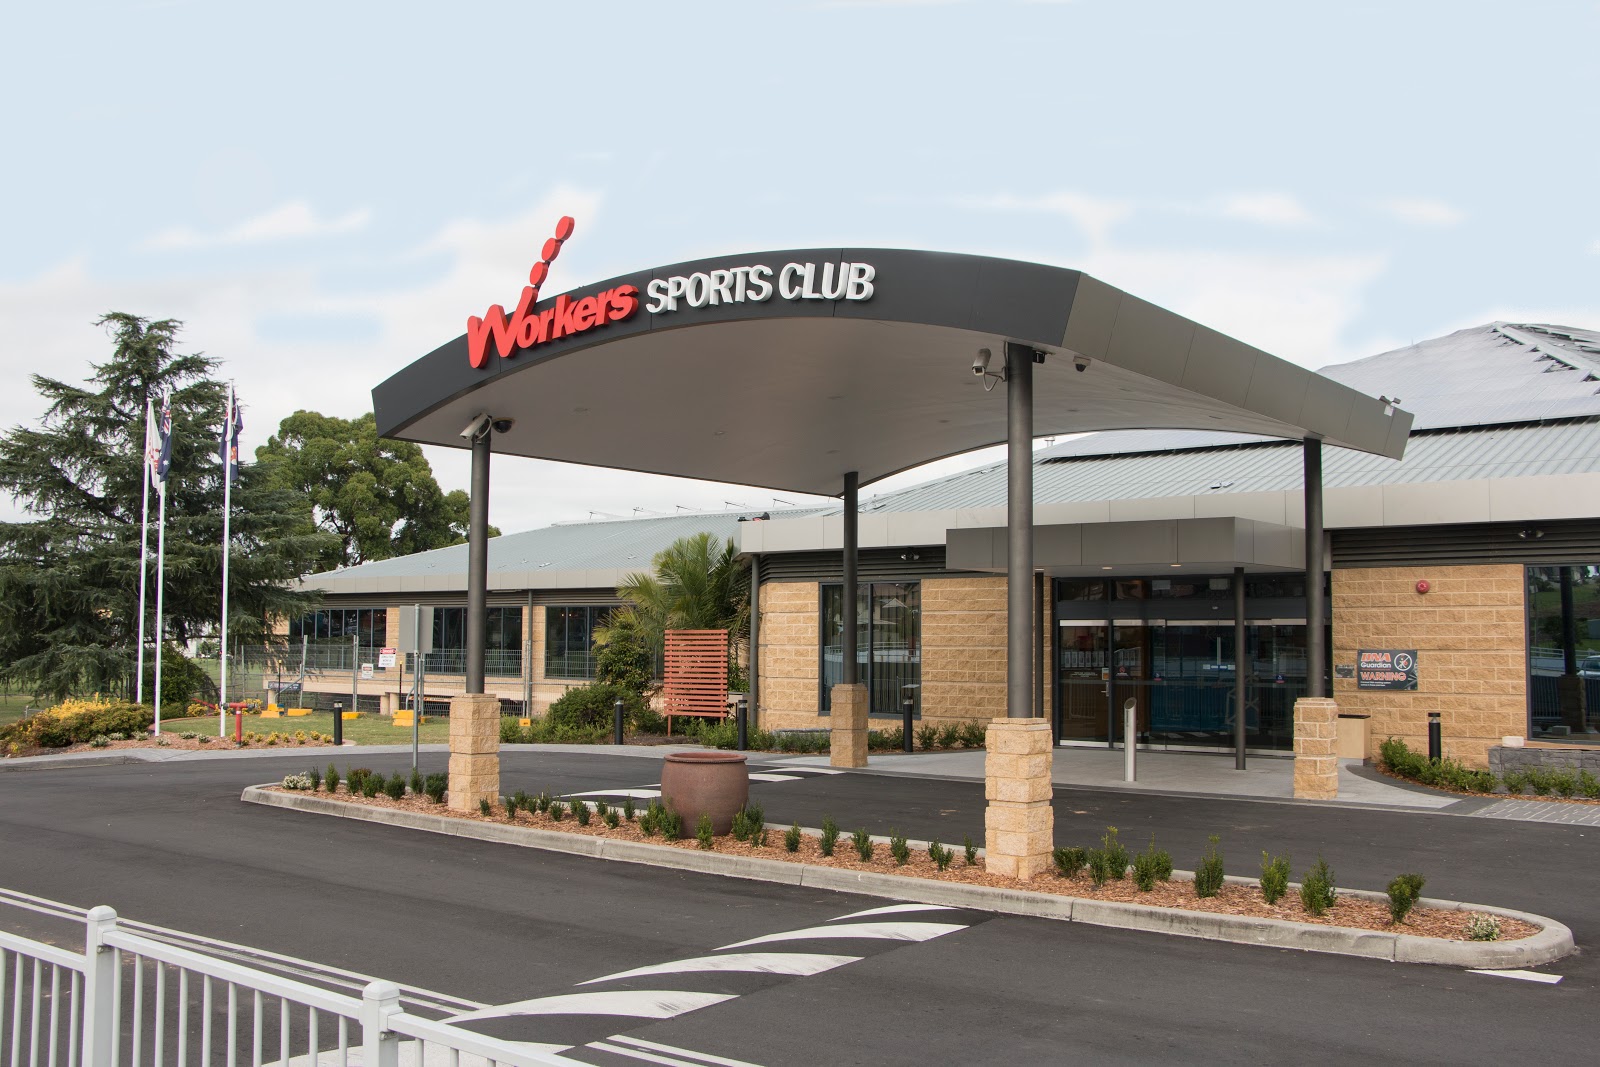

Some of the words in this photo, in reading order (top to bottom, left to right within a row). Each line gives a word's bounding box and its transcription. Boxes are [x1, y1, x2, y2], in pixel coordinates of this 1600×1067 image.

[467, 284, 639, 369] Workers
[646, 264, 773, 315] SPORTS
[778, 262, 876, 302] CLUB
[1360, 671, 1407, 682] WARNING
